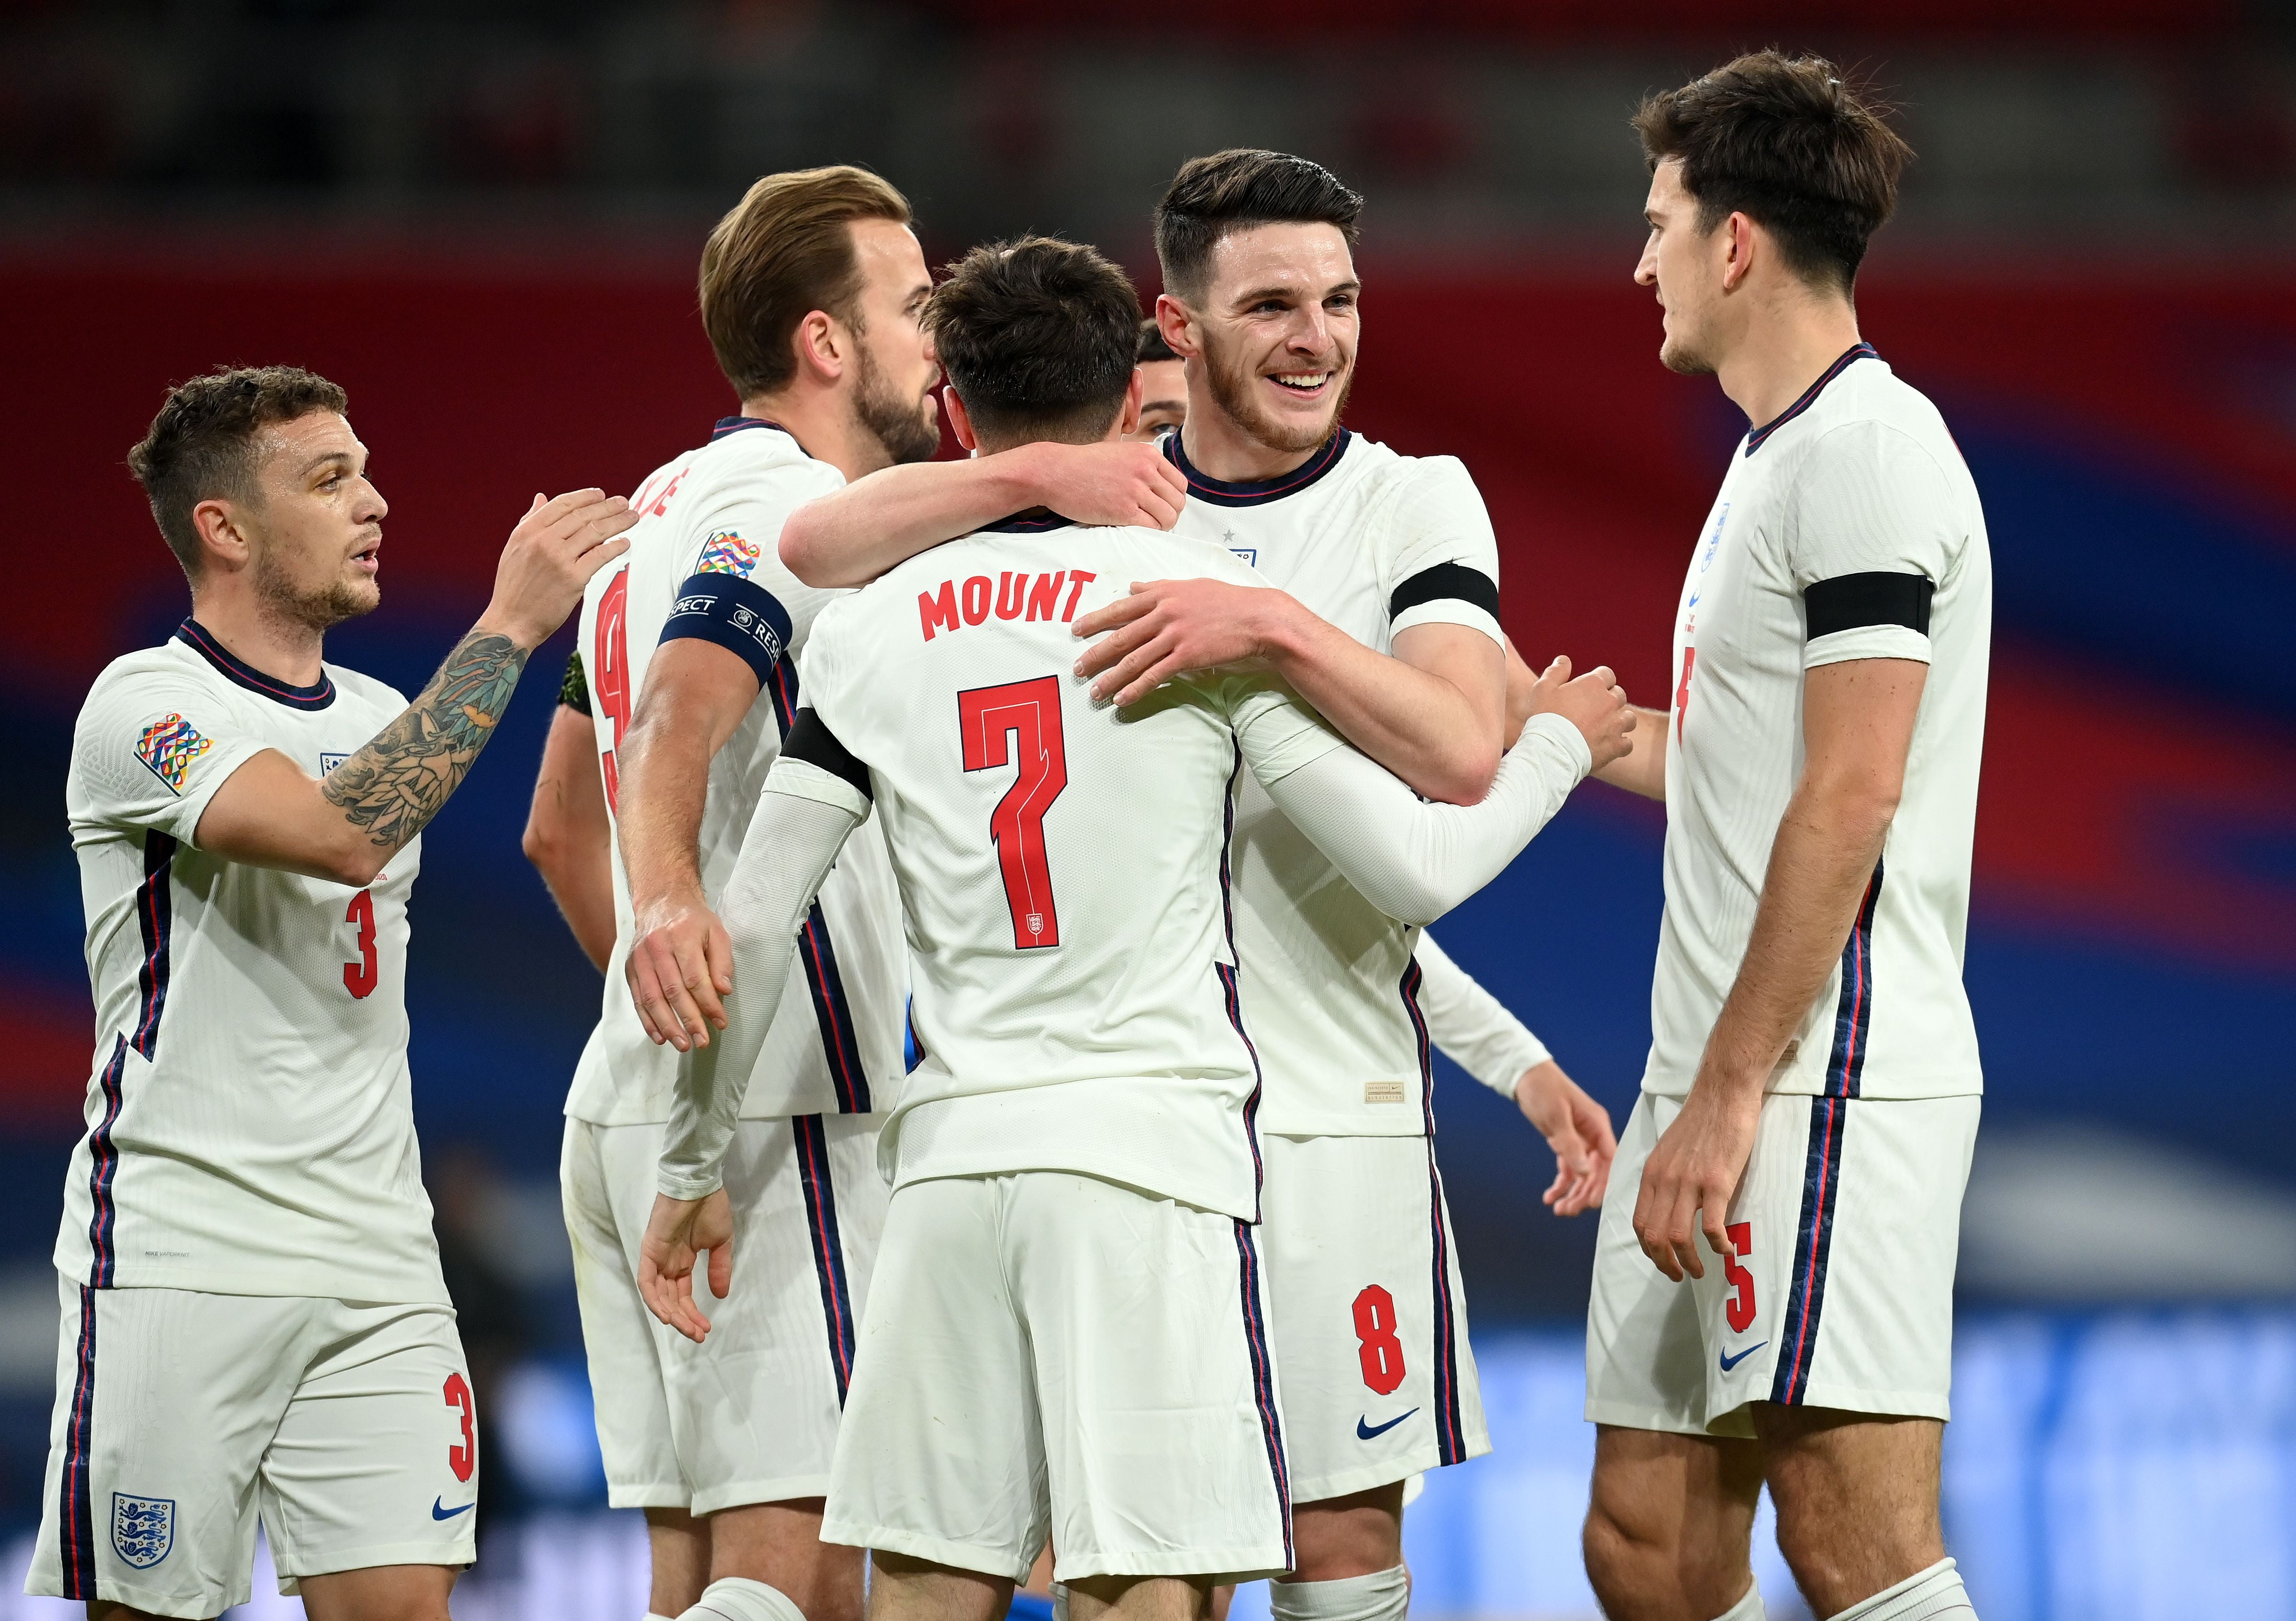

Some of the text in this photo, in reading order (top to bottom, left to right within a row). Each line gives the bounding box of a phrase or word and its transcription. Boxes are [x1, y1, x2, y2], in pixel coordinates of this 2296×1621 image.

[918, 569, 1097, 642] MOUNT
[957, 674, 1067, 950] 7
[343, 888, 377, 999] 3
[1724, 1222, 1757, 1333] 5
[1351, 1284, 1406, 1395] 8
[443, 1372, 474, 1483] 3
